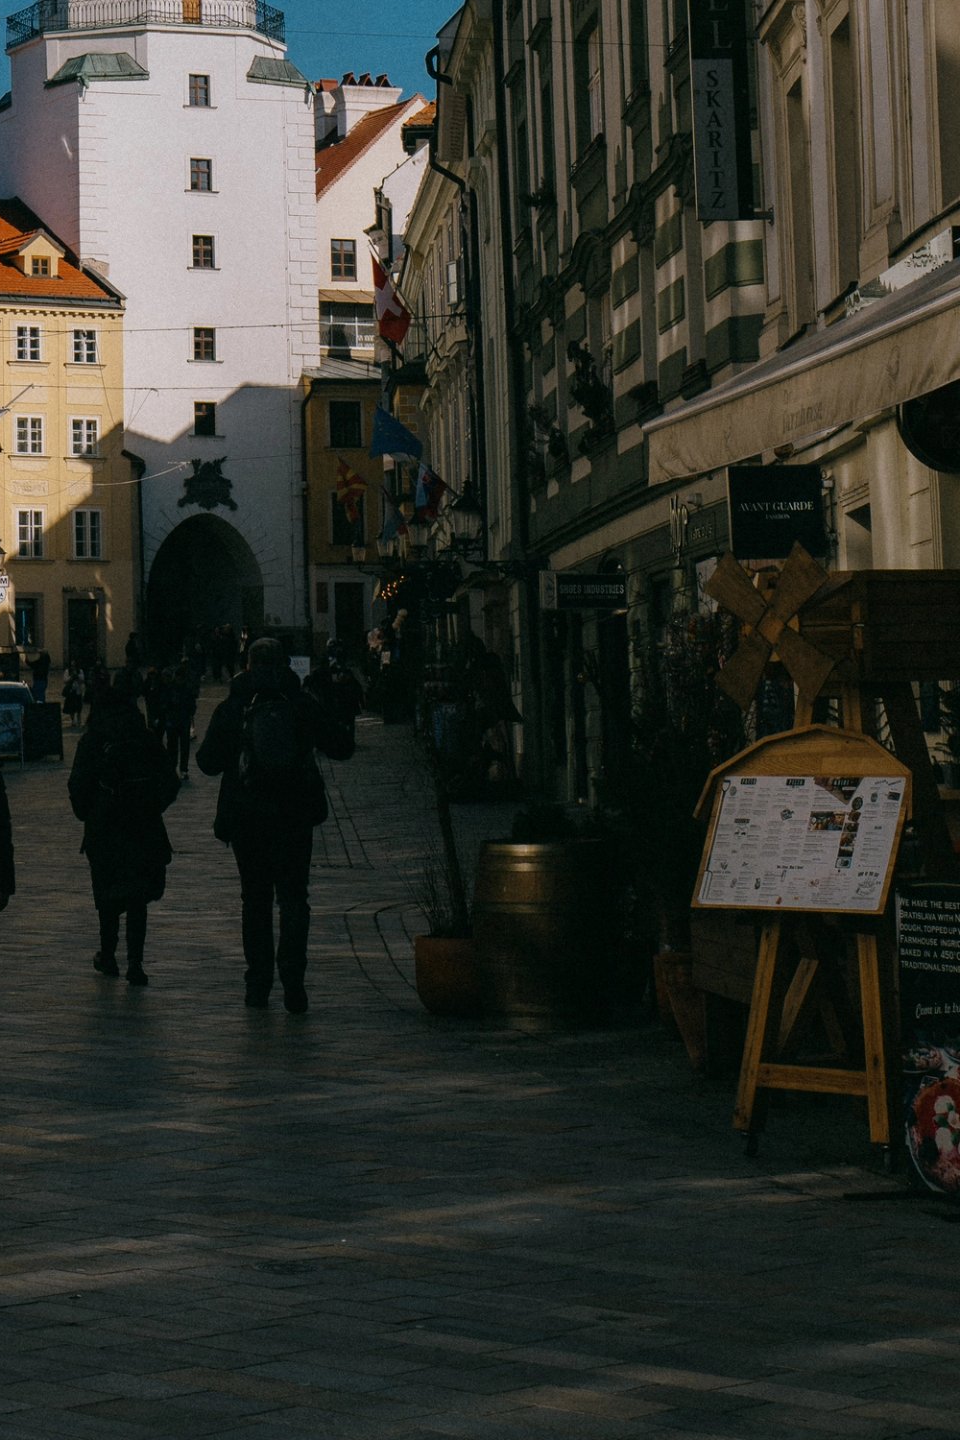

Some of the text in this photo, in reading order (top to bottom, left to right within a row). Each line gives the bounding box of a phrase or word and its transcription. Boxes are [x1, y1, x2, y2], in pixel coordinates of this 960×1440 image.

[705, 69, 727, 210] SKARITZ
[739, 500, 814, 512] AVANT GUARDE
[559, 584, 624, 594] SHOES INDUSTRIES
[900, 897, 960, 910] WE HAVE THE BEST
[900, 909, 936, 920] BRATISLAVA
[937, 913, 953, 922] WITH
[924, 925, 947, 934] TOPPED
[948, 926, 957, 935] UP
[900, 934, 938, 946] FARMHOUSE
[900, 948, 921, 957] BAKED
[923, 950, 930, 958] IN
[901, 960, 941, 972] TRADITIONAL
